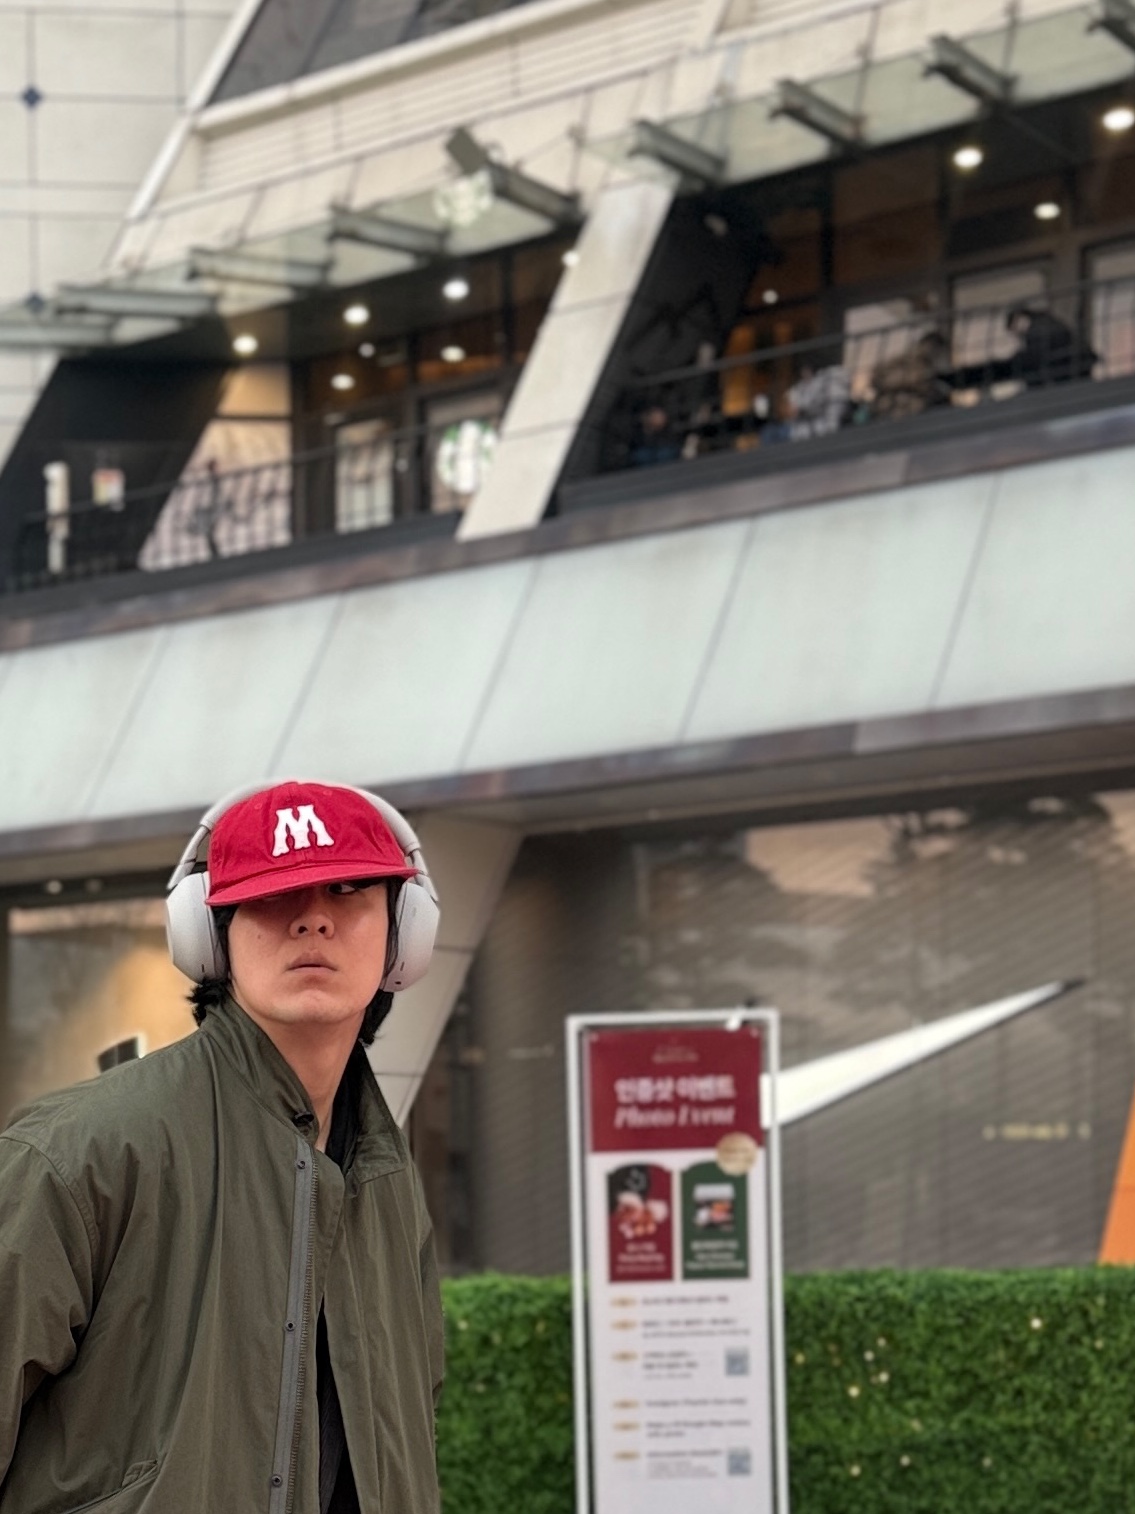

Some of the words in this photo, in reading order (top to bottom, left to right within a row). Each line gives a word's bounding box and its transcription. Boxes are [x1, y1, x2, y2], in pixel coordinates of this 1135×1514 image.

[272, 804, 335, 857] M
[676, 1074, 736, 1101] 이벤트
[614, 1105, 675, 1129] Photo
